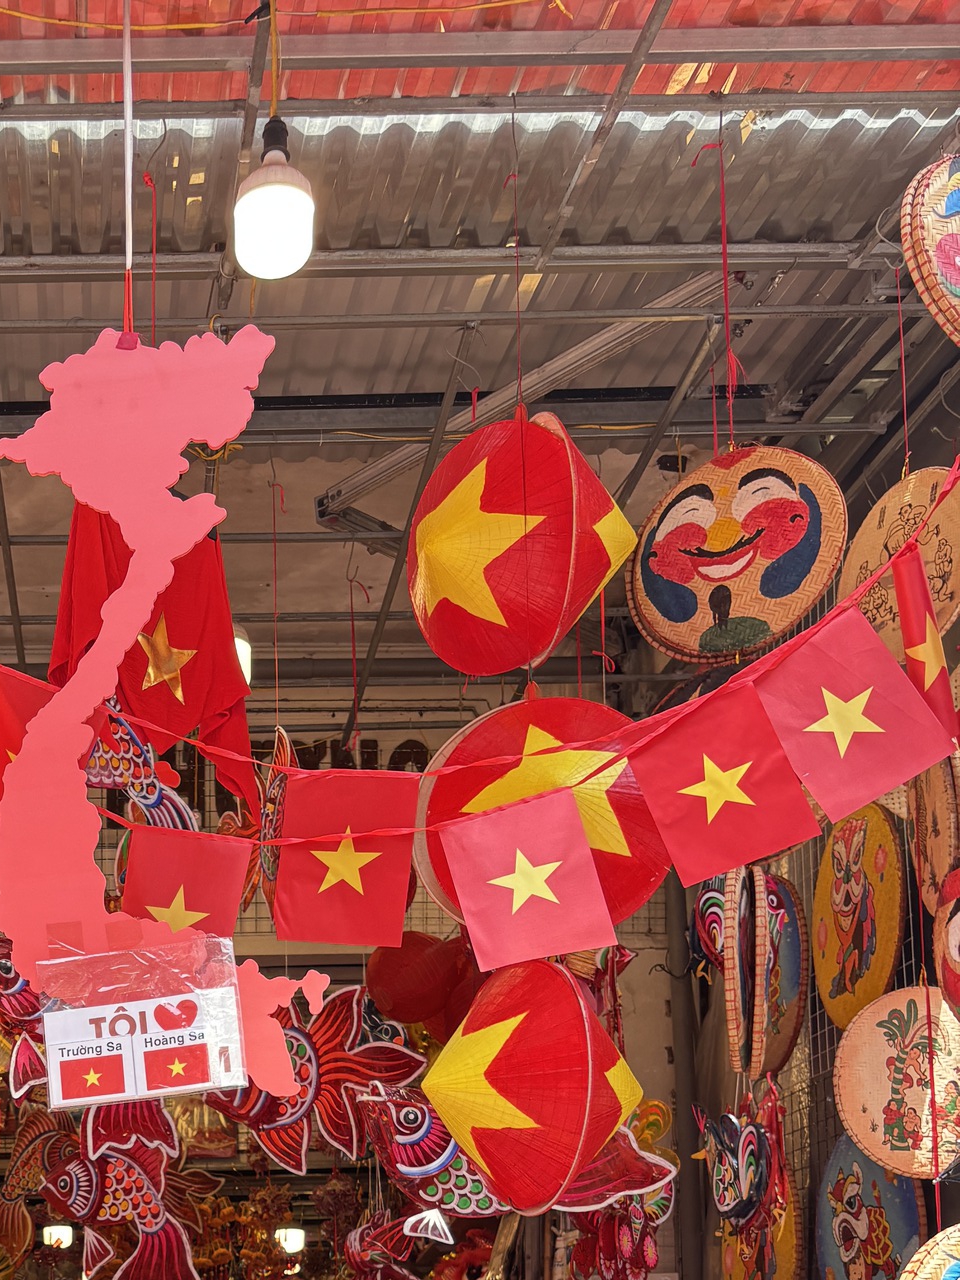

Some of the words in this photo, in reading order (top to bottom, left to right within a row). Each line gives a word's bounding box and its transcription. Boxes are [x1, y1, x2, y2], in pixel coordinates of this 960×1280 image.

[88, 1006, 148, 1039] TÔI
[144, 1033, 185, 1049] Hoàng
[188, 1031, 205, 1042] Sa
[58, 1042, 102, 1059] Trường
[106, 1041, 123, 1051] Sa
